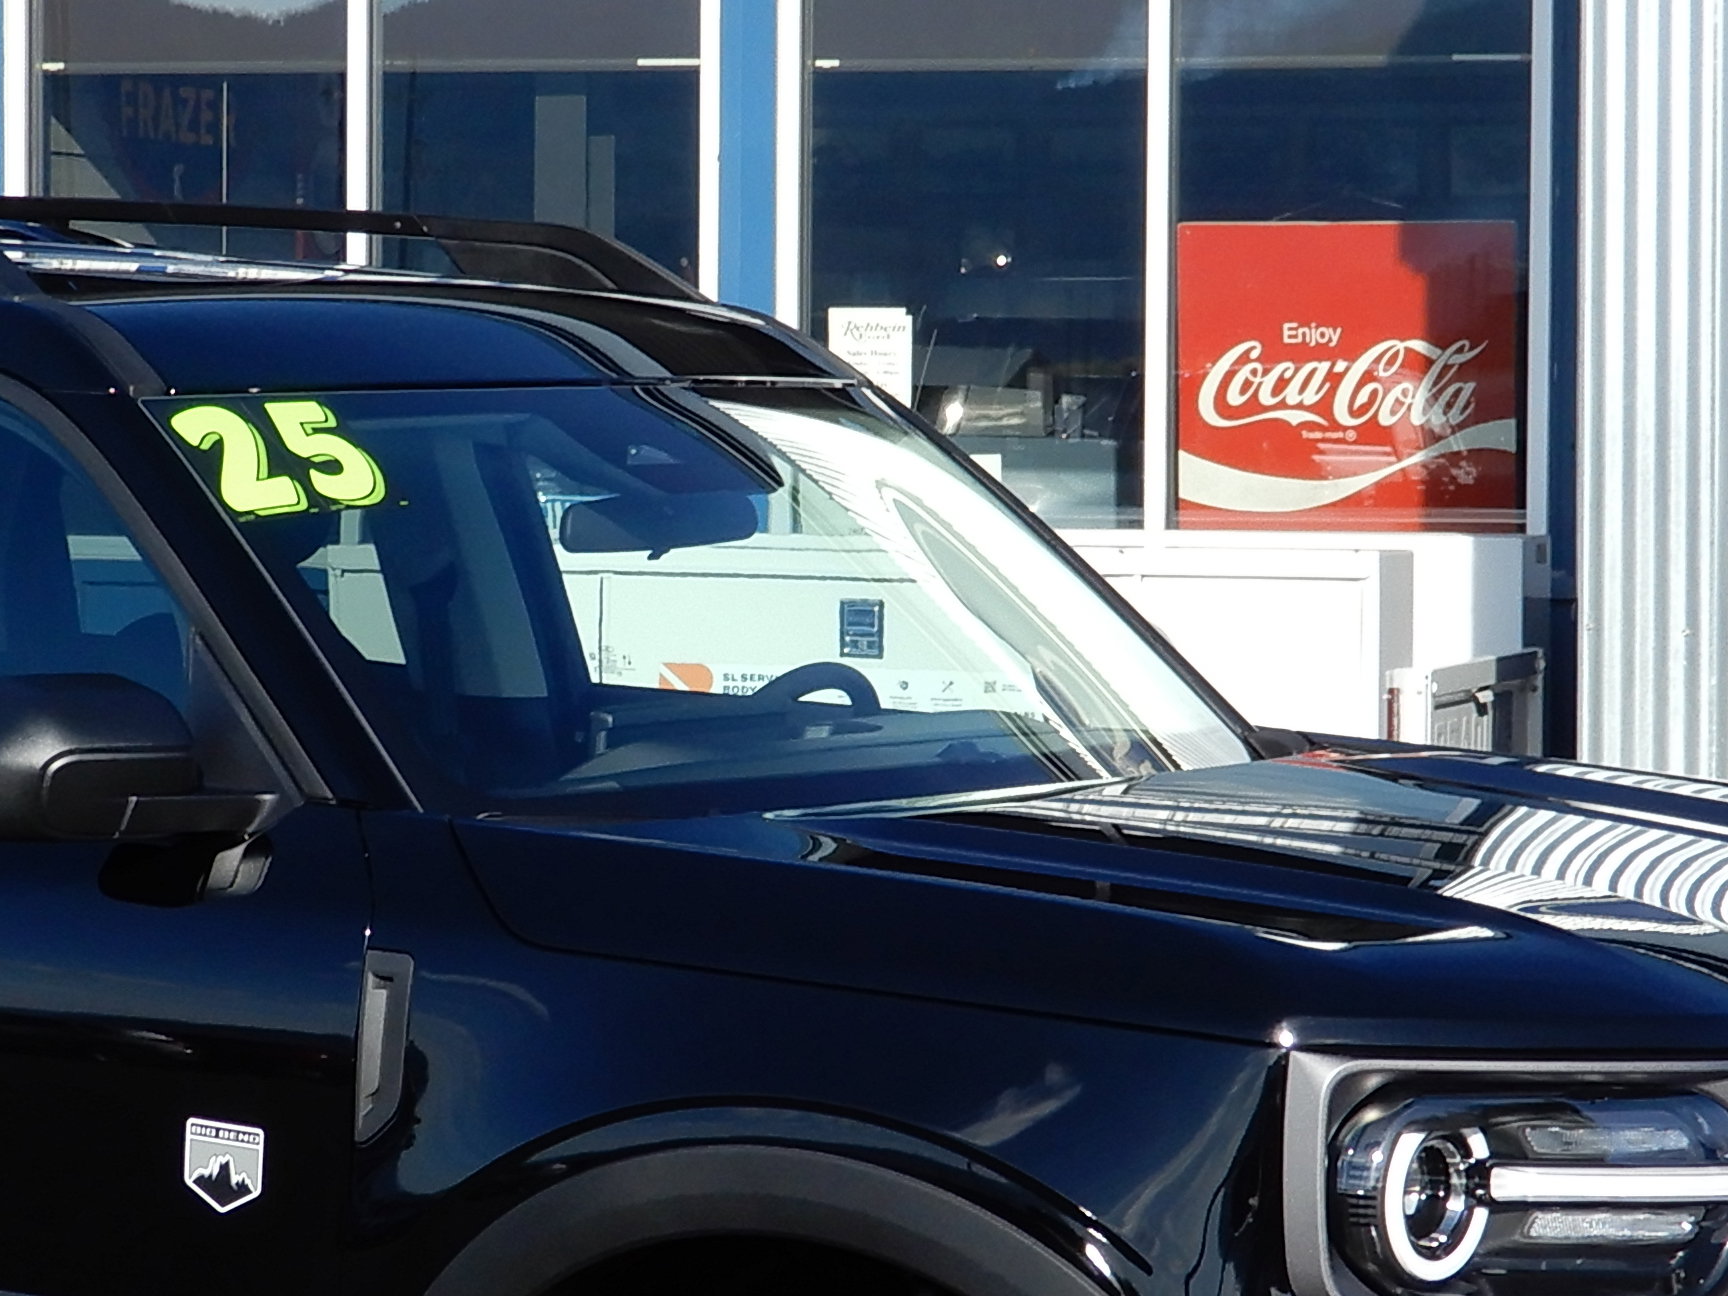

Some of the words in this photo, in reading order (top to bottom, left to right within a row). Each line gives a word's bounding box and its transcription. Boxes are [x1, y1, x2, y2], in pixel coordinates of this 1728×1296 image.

[1282, 322, 1342, 347] Enjoy
[1198, 339, 1488, 428] Coca-Cola
[170, 400, 386, 516] 25
[191, 1125, 216, 1137] BIG
[218, 1129, 260, 1144] BEND
